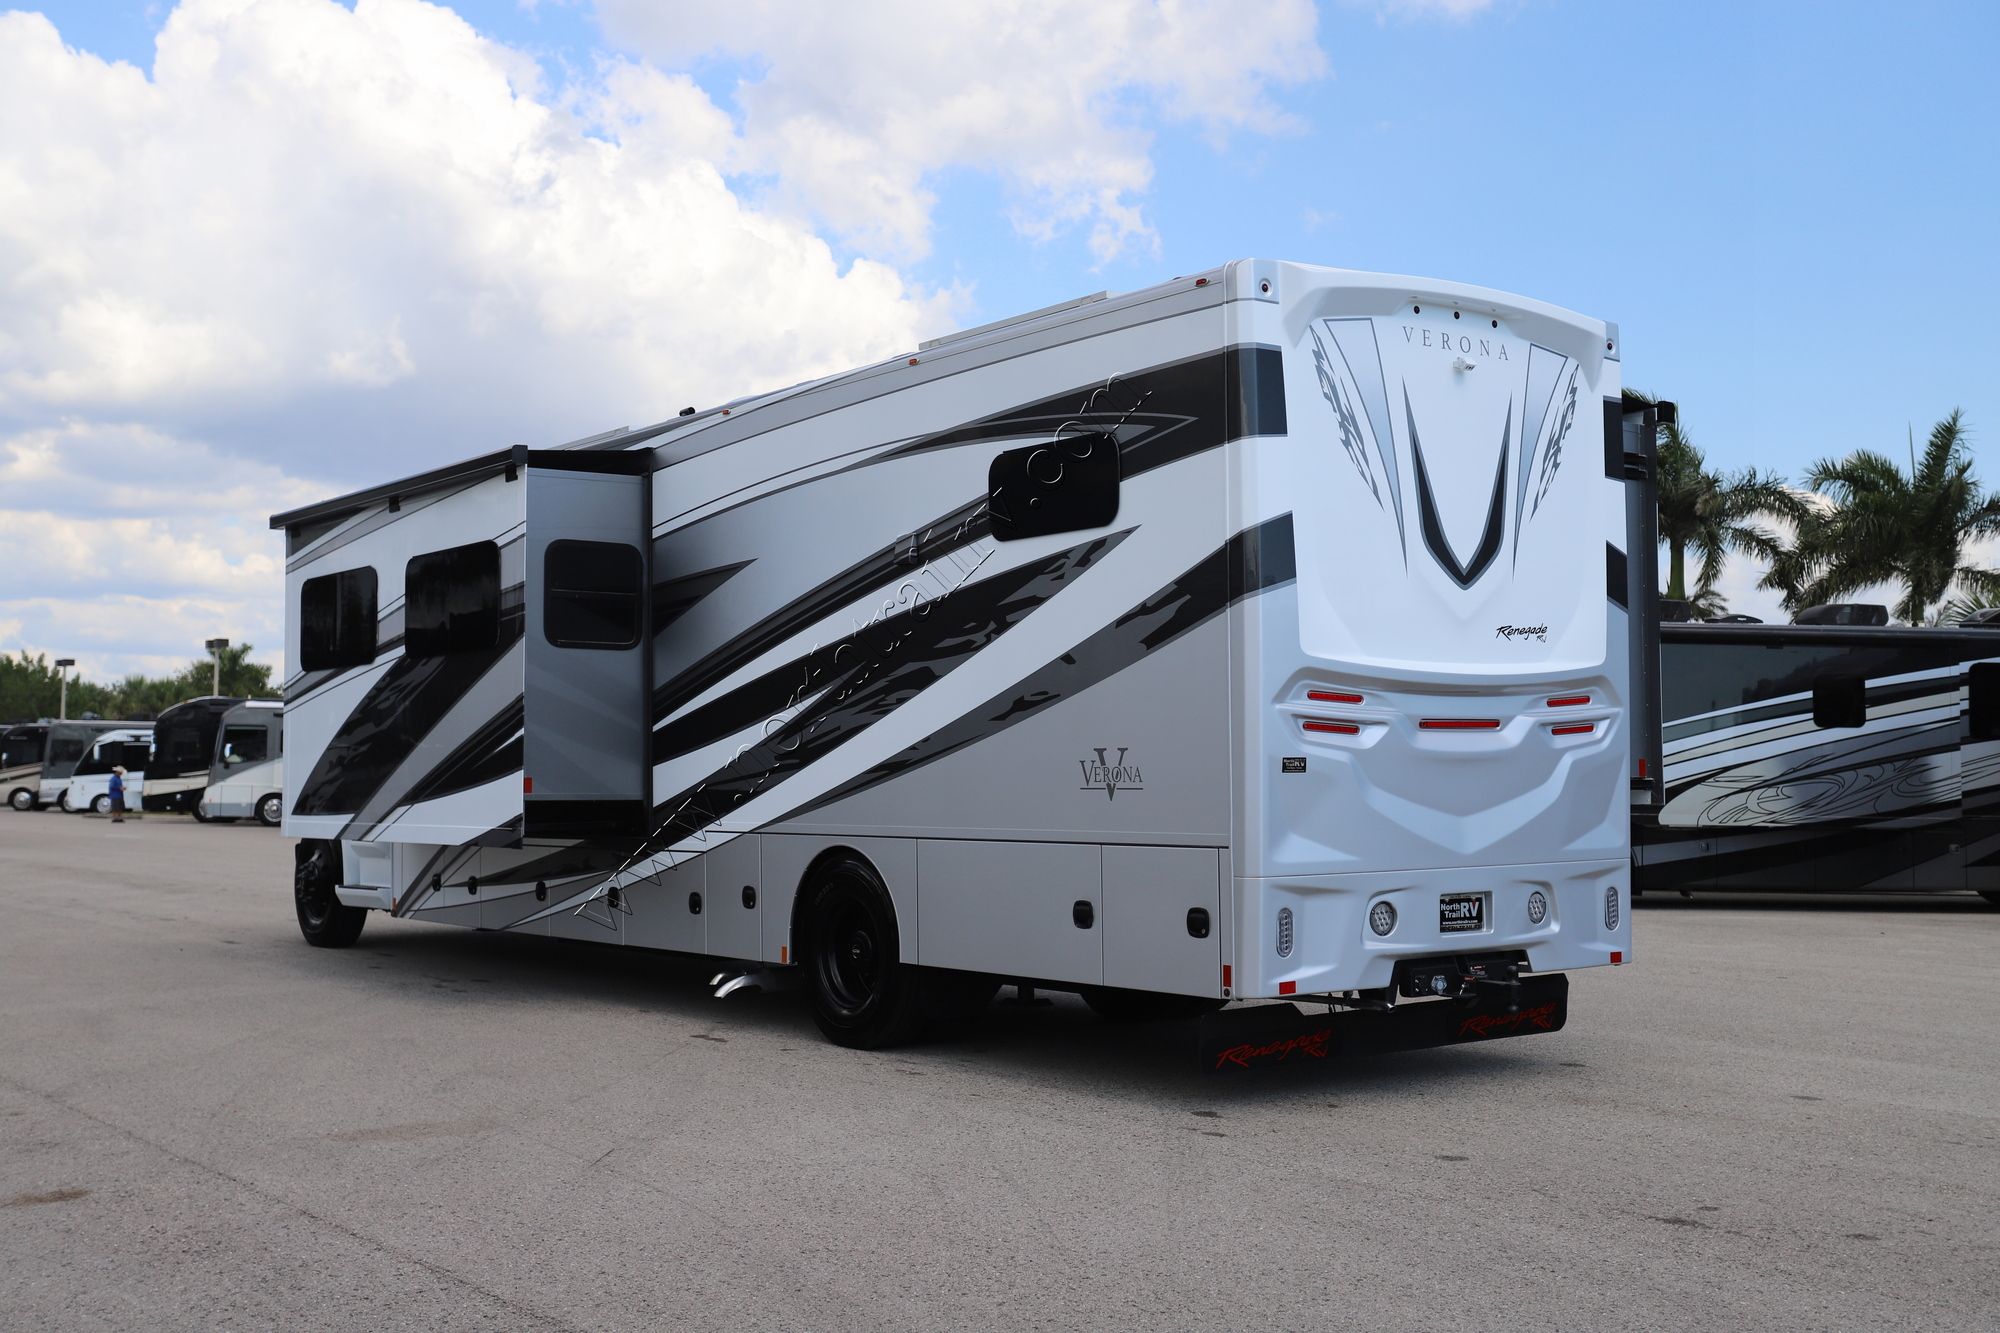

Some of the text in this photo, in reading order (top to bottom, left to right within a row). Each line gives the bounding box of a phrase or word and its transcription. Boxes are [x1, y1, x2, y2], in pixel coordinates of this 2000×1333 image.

[1402, 325, 1508, 361] VERONA
[1495, 622, 1548, 641] Renegade
[1536, 634, 1547, 643] RV
[1079, 760, 1143, 787] VERONA
[1460, 902, 1479, 917] RV
[1457, 1002, 1557, 1037] Renegade
[1216, 1029, 1332, 1070] Renegade
